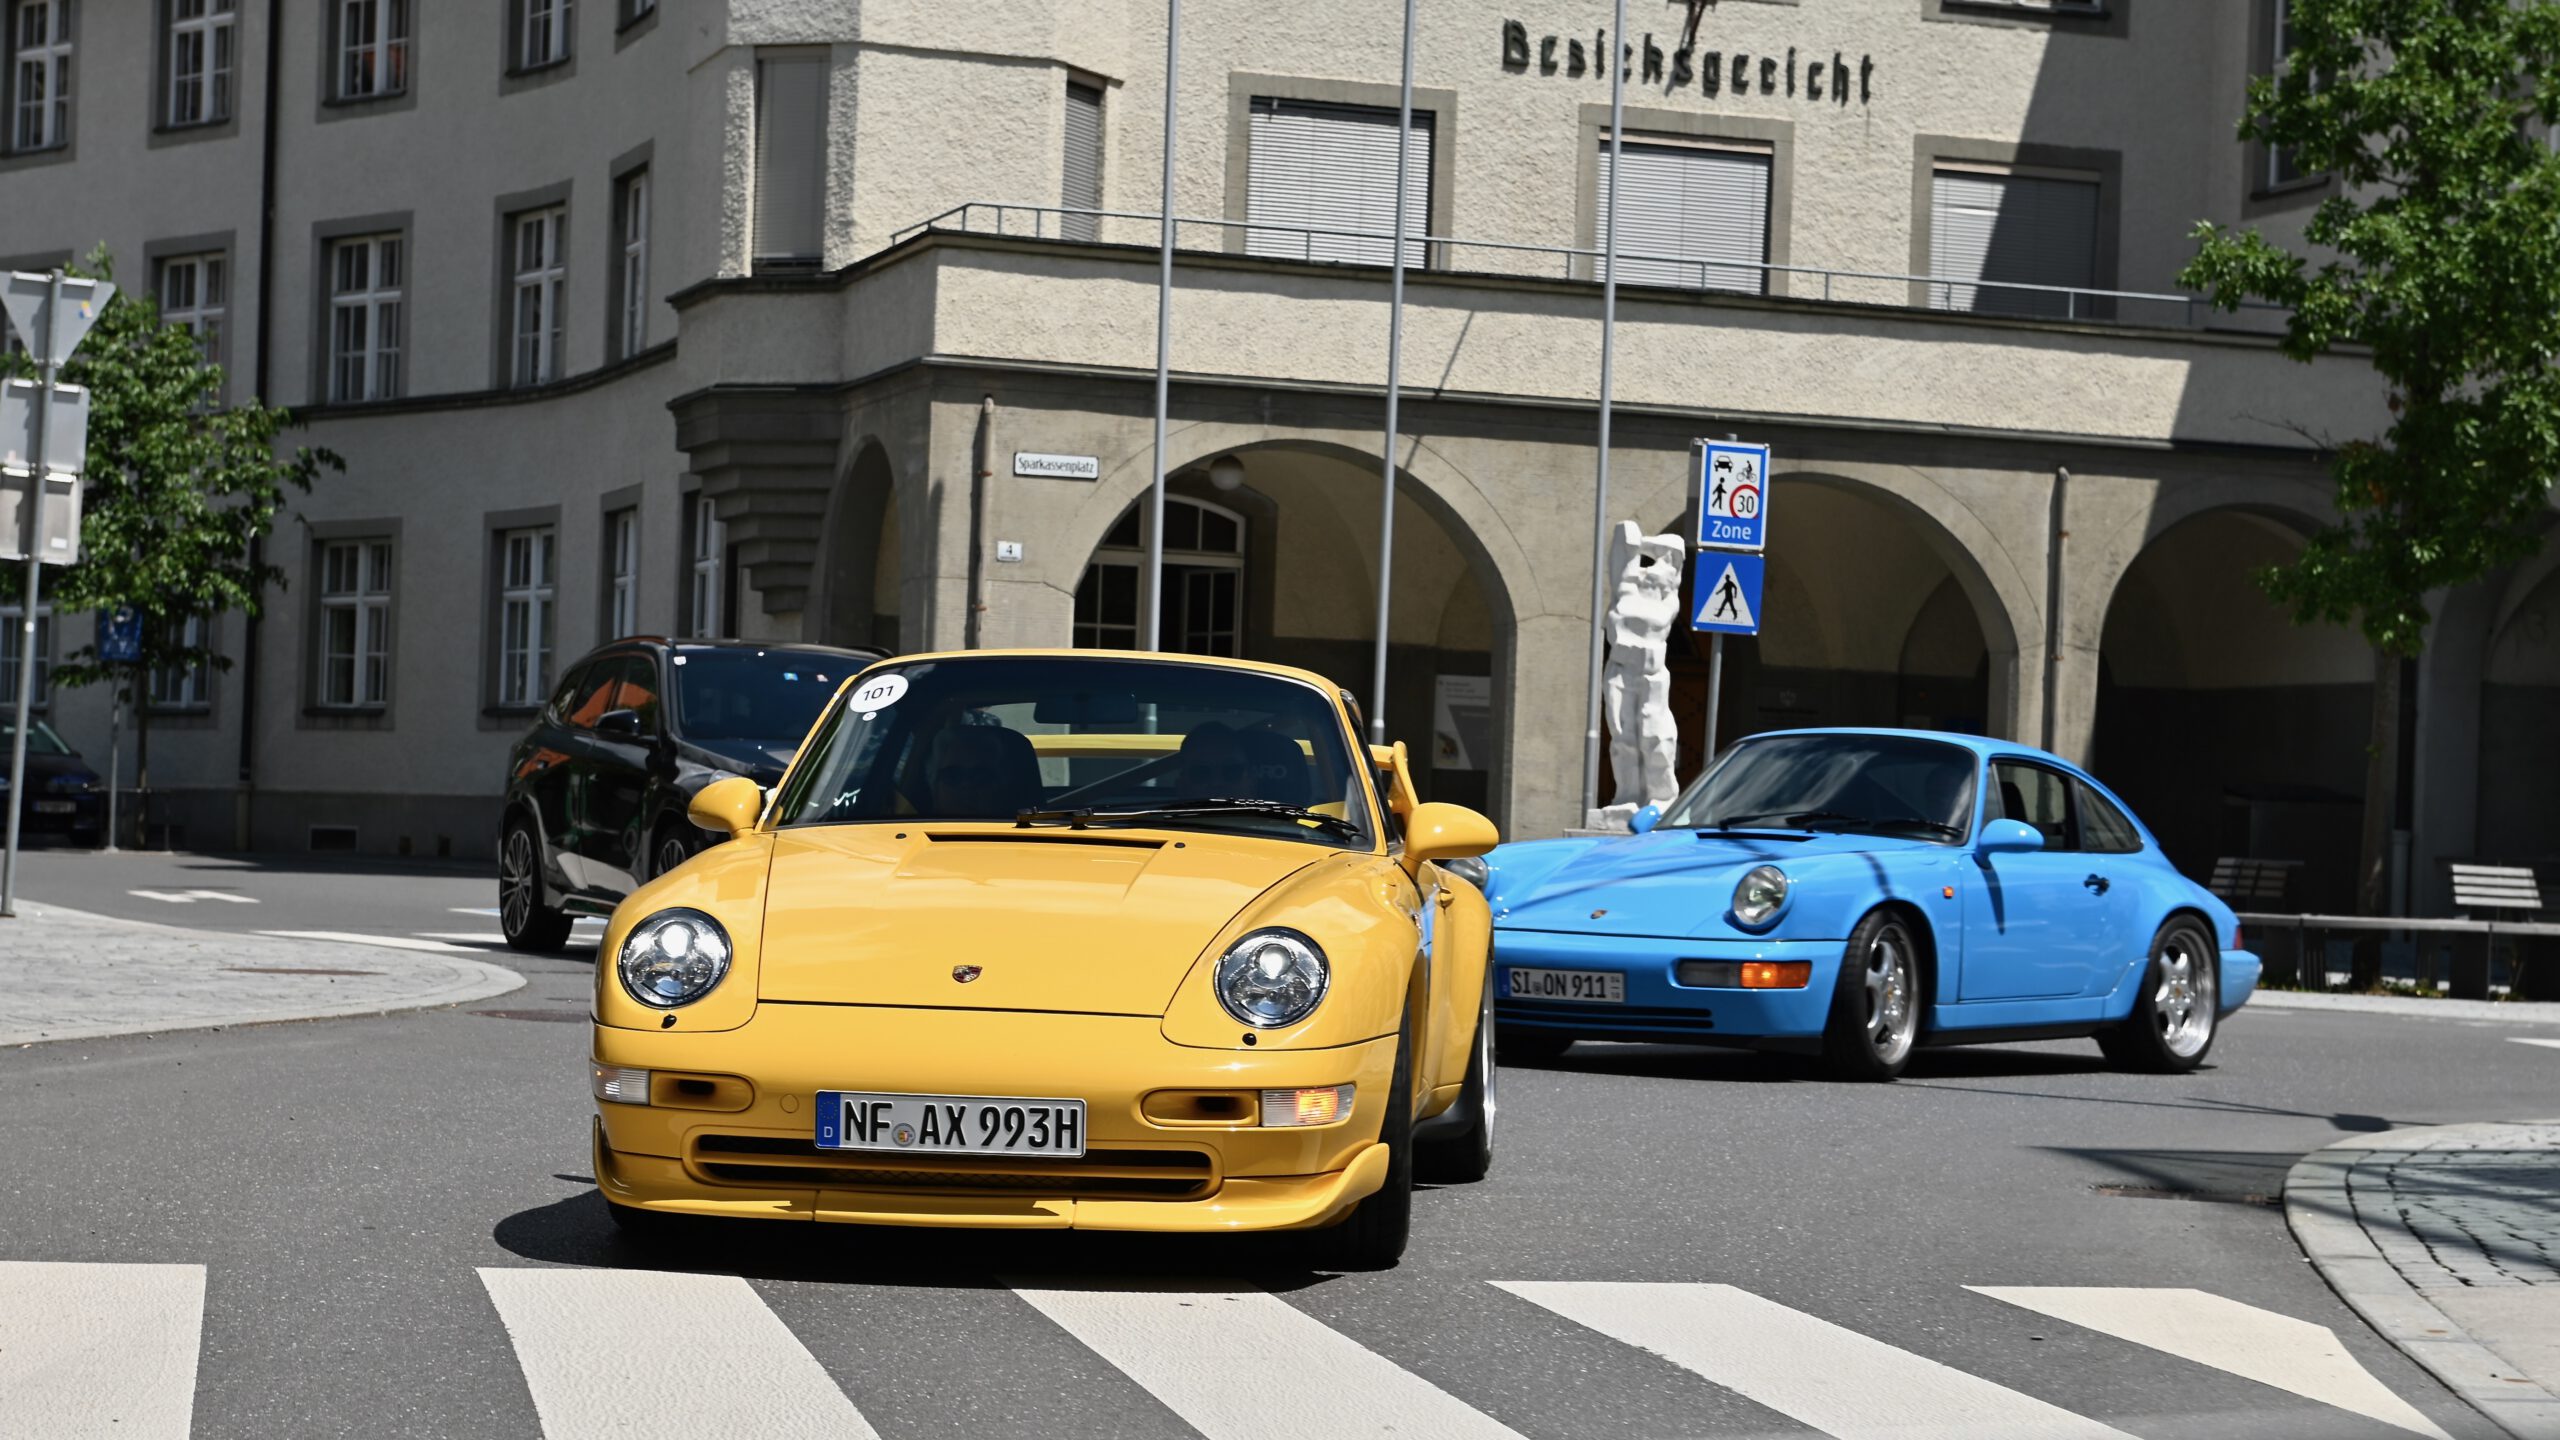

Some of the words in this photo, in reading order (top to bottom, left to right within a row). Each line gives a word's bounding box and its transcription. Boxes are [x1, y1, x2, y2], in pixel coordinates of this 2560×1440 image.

[1018, 457, 1095, 475] Sparkassenplatz
[1737, 494, 1755, 514] 30
[1711, 520, 1752, 540] Zone
[1006, 544, 1013, 555] 4
[863, 685, 894, 701] 101
[1511, 970, 1531, 994] SI
[1543, 972, 1567, 997] ON
[1572, 974, 1607, 999] 911
[823, 1126, 834, 1138] D
[844, 1100, 893, 1143] NF
[919, 1104, 968, 1146] AX
[979, 1105, 1079, 1149] 993H
